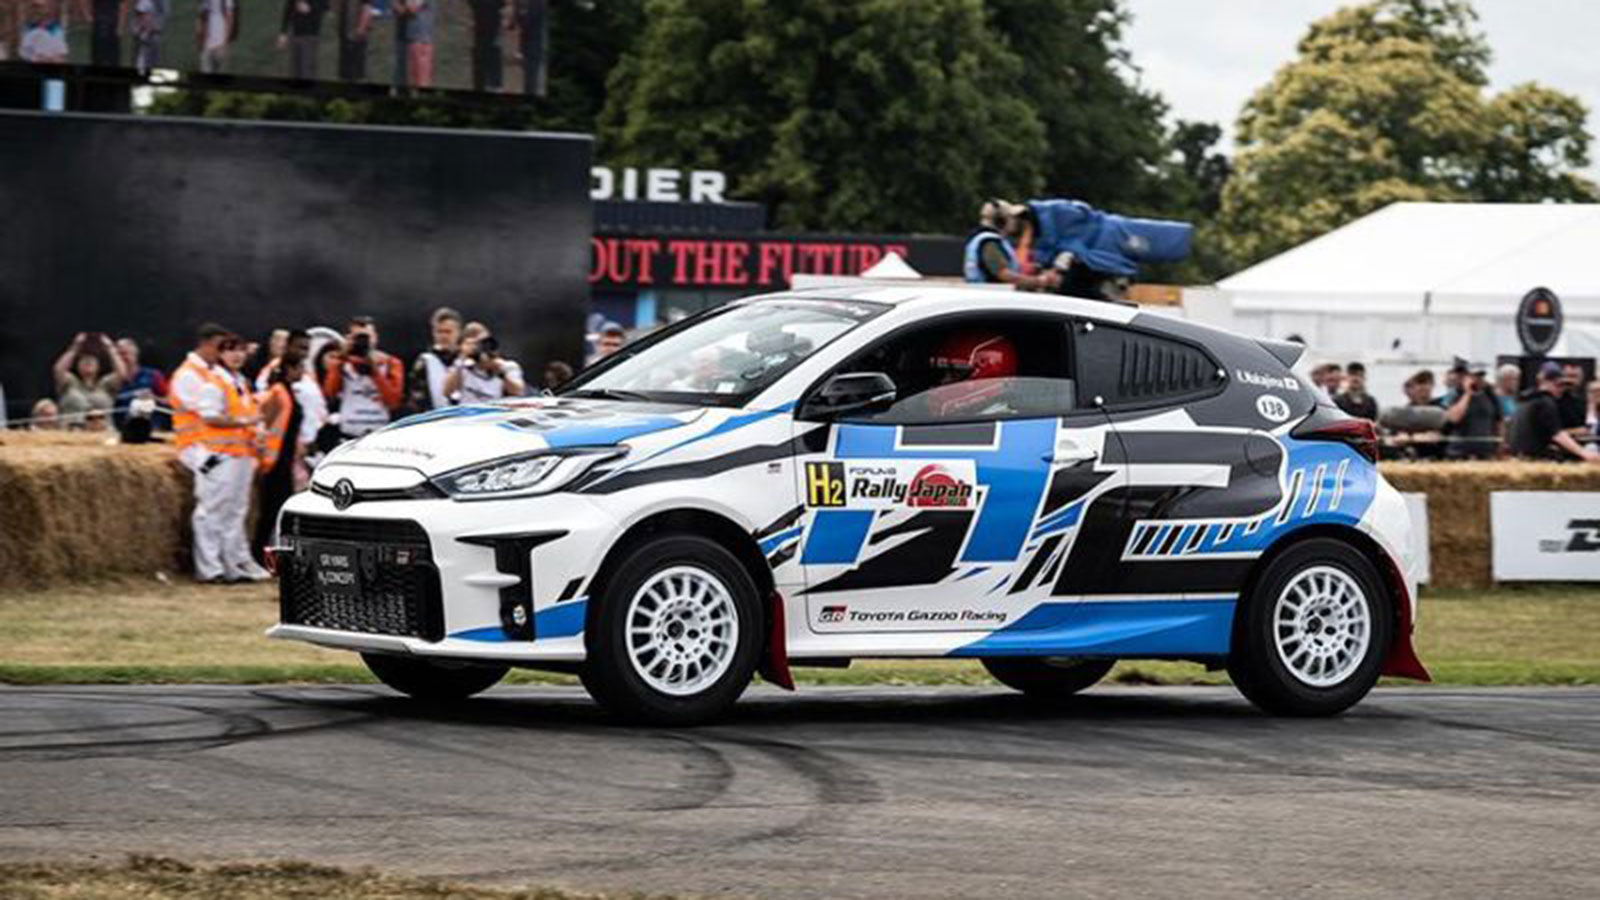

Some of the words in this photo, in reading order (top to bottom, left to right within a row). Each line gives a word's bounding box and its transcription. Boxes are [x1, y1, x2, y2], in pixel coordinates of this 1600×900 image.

[669, 239, 750, 285] THE
[756, 241, 909, 285] FUTUR
[807, 463, 844, 506] H2
[851, 477, 908, 503] Rally
[909, 479, 973, 503] Japan
[850, 610, 904, 621] TOYOTA
[907, 610, 958, 621] GAZOO
[960, 609, 1007, 622] Racing
